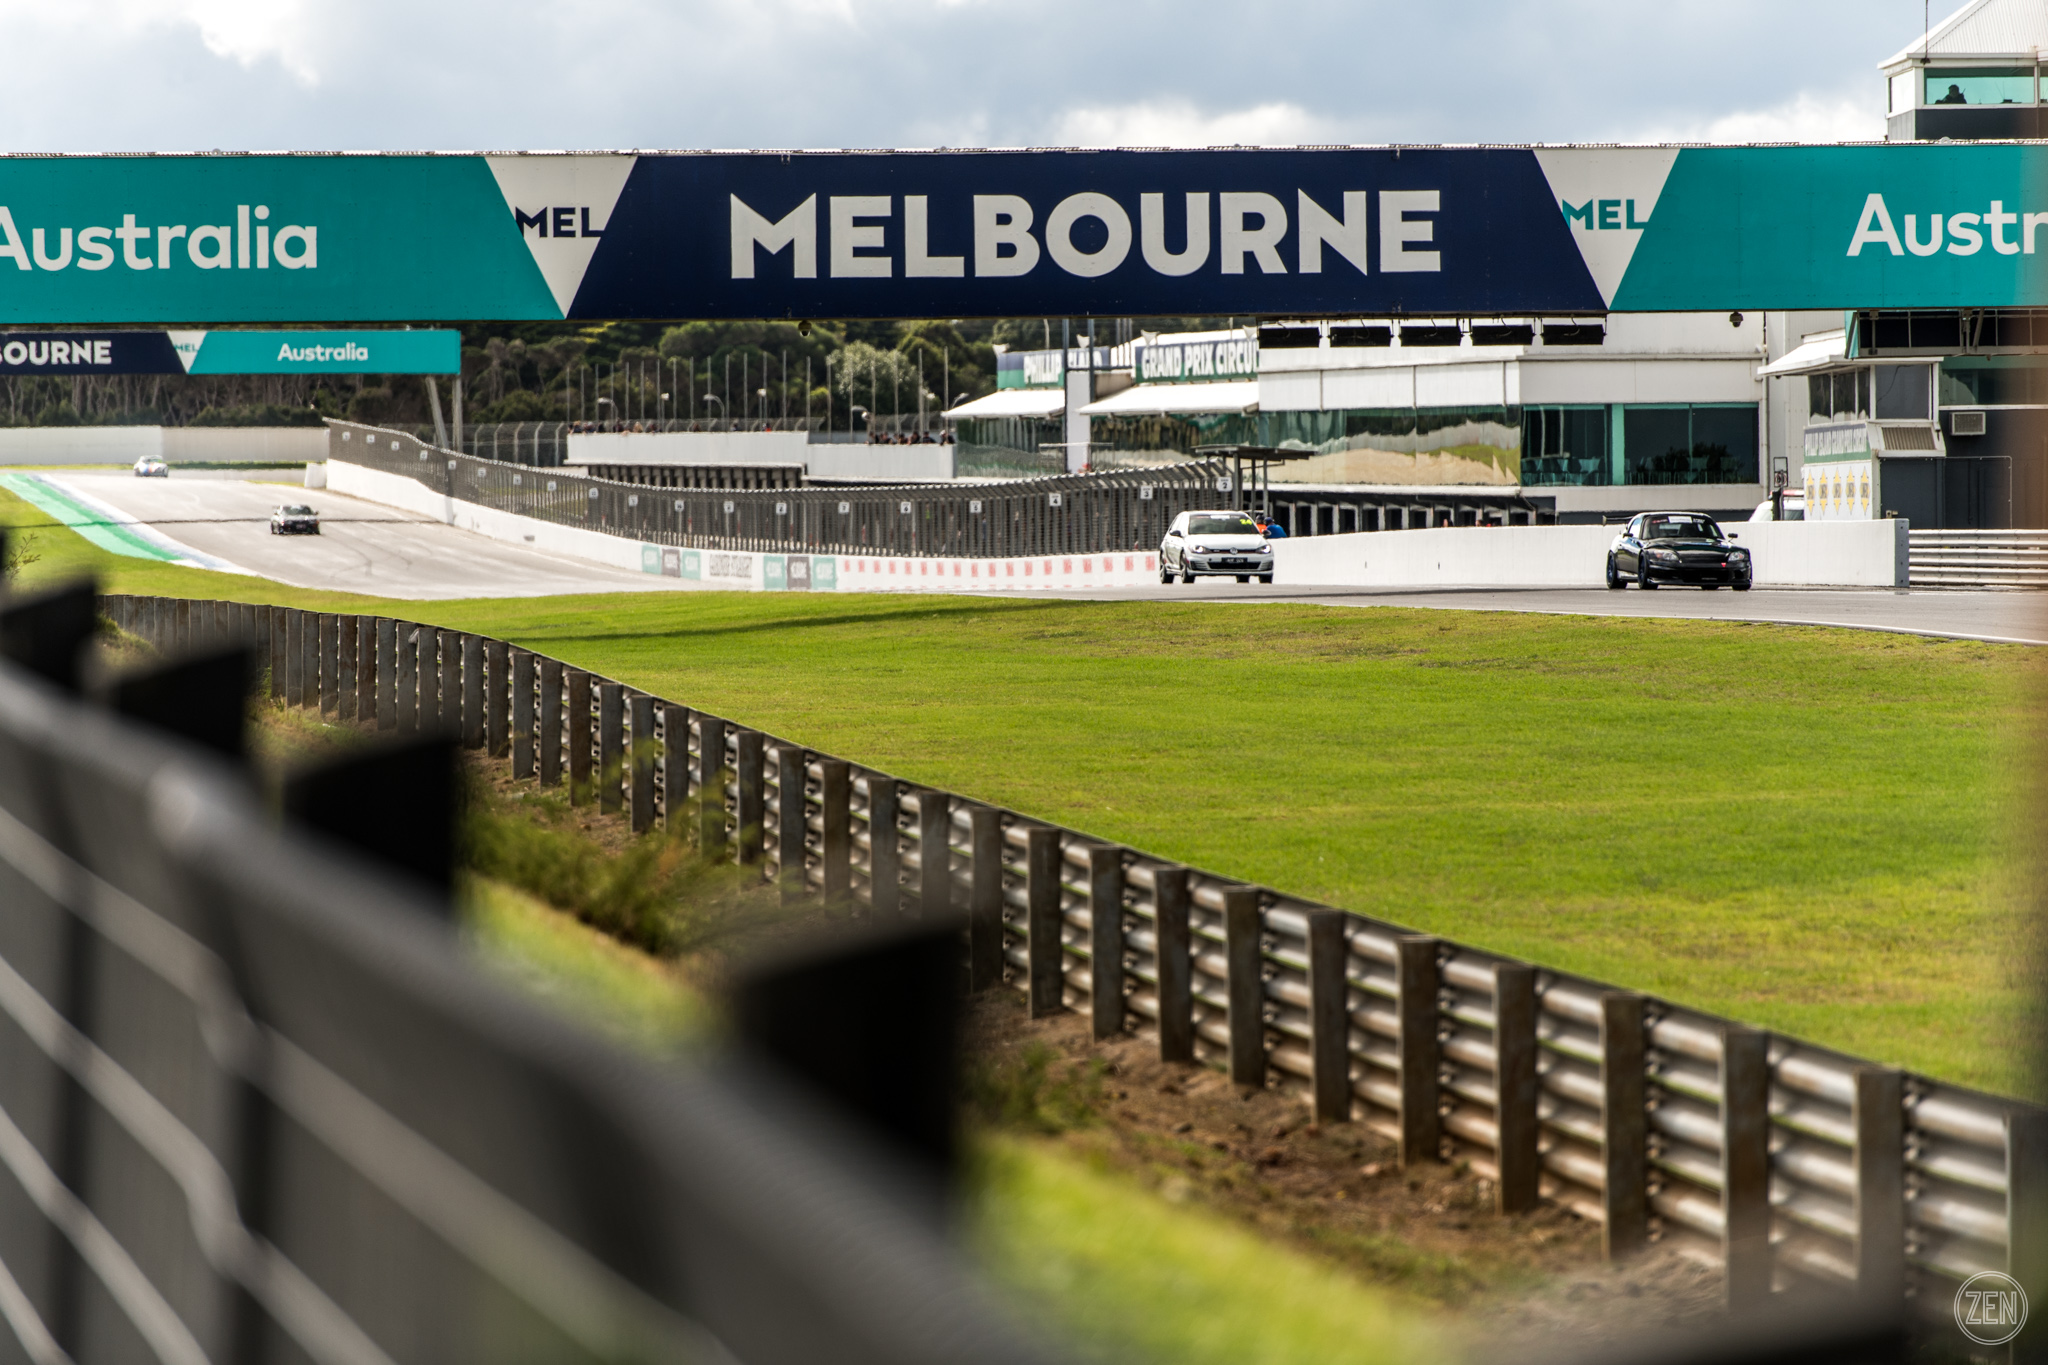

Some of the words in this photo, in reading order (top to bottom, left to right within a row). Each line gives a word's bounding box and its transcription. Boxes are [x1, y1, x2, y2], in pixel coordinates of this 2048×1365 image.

[515, 206, 604, 238] MEL
[1562, 198, 1648, 230] MEL
[730, 188, 1441, 279] MELBOURNE
[0, 340, 112, 366] OURNE
[277, 343, 369, 362] Australia
[1024, 352, 1062, 384] PHILLIP
[1141, 345, 1182, 379] GRAND
[1184, 343, 1214, 376] PRIX
[1215, 340, 1259, 375] CIRCUI
